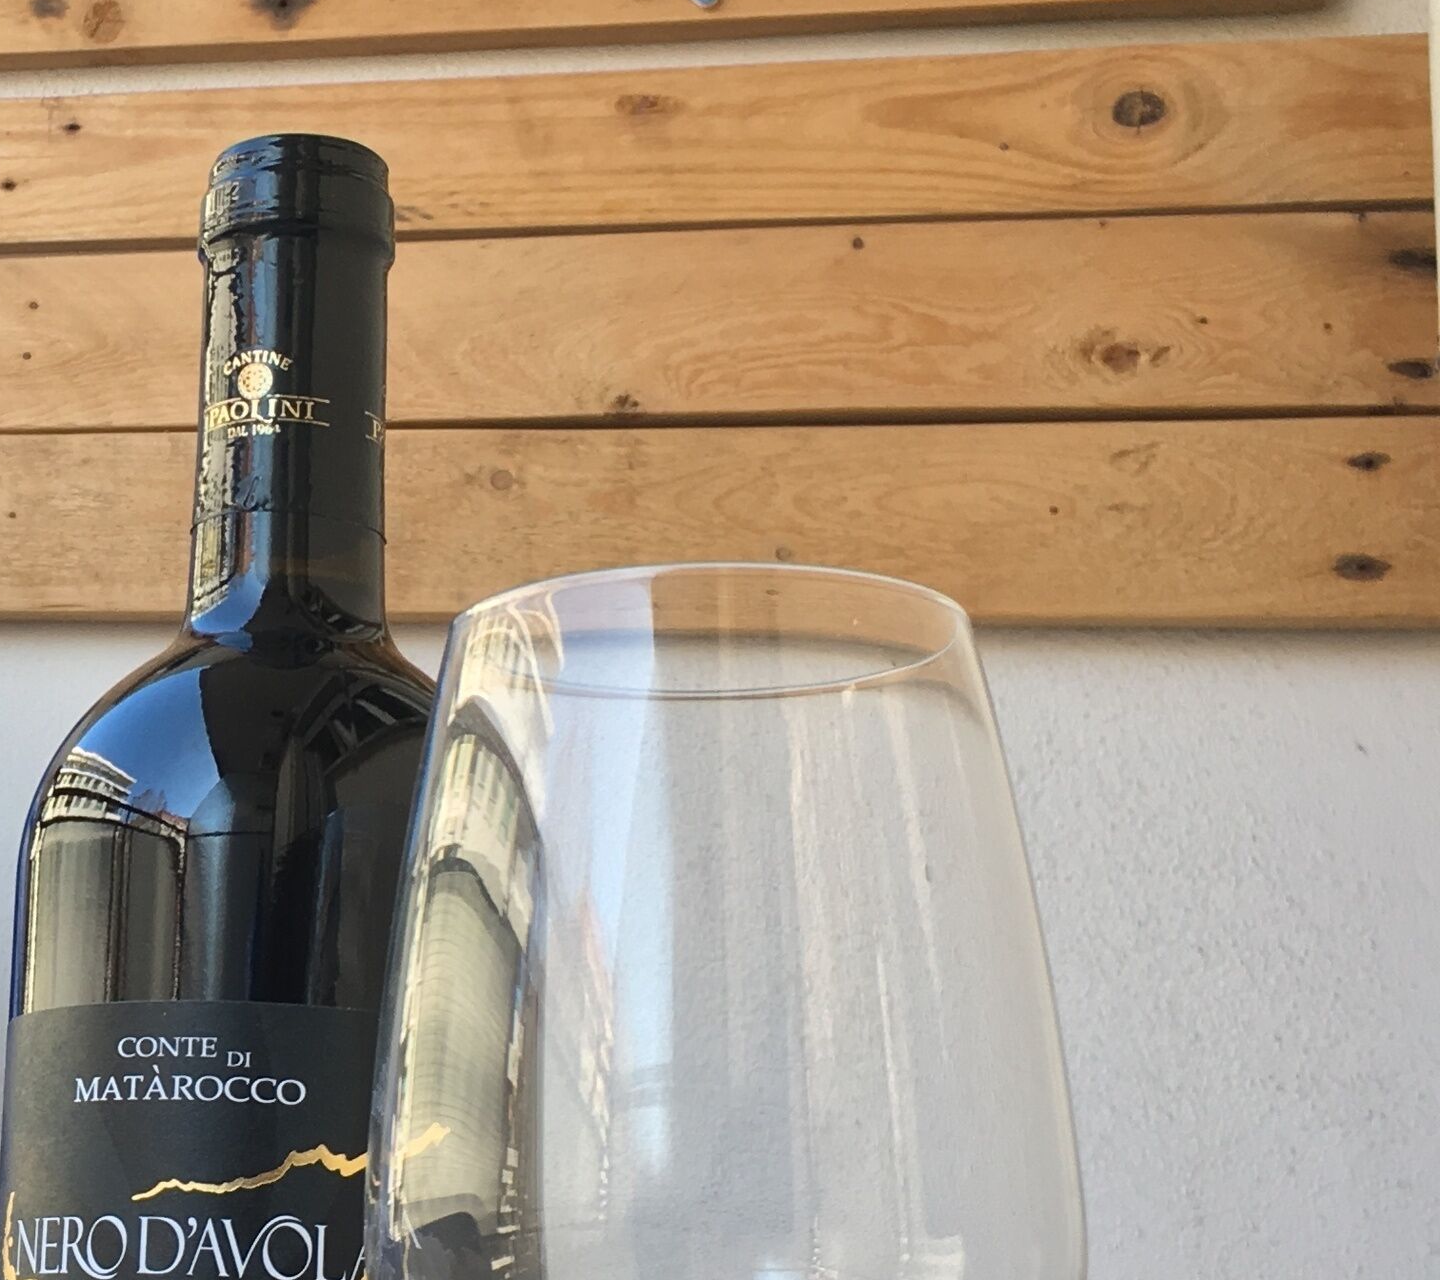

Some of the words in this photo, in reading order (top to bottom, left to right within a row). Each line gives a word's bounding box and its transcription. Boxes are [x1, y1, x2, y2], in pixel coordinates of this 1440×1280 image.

[223, 350, 293, 376] CANTINE
[209, 398, 315, 427] PAOLINI
[118, 1037, 218, 1058] CONTE
[227, 1050, 252, 1068] DI
[74, 1066, 306, 1106] MATÀROCCO
[15, 1214, 128, 1279] NERO
